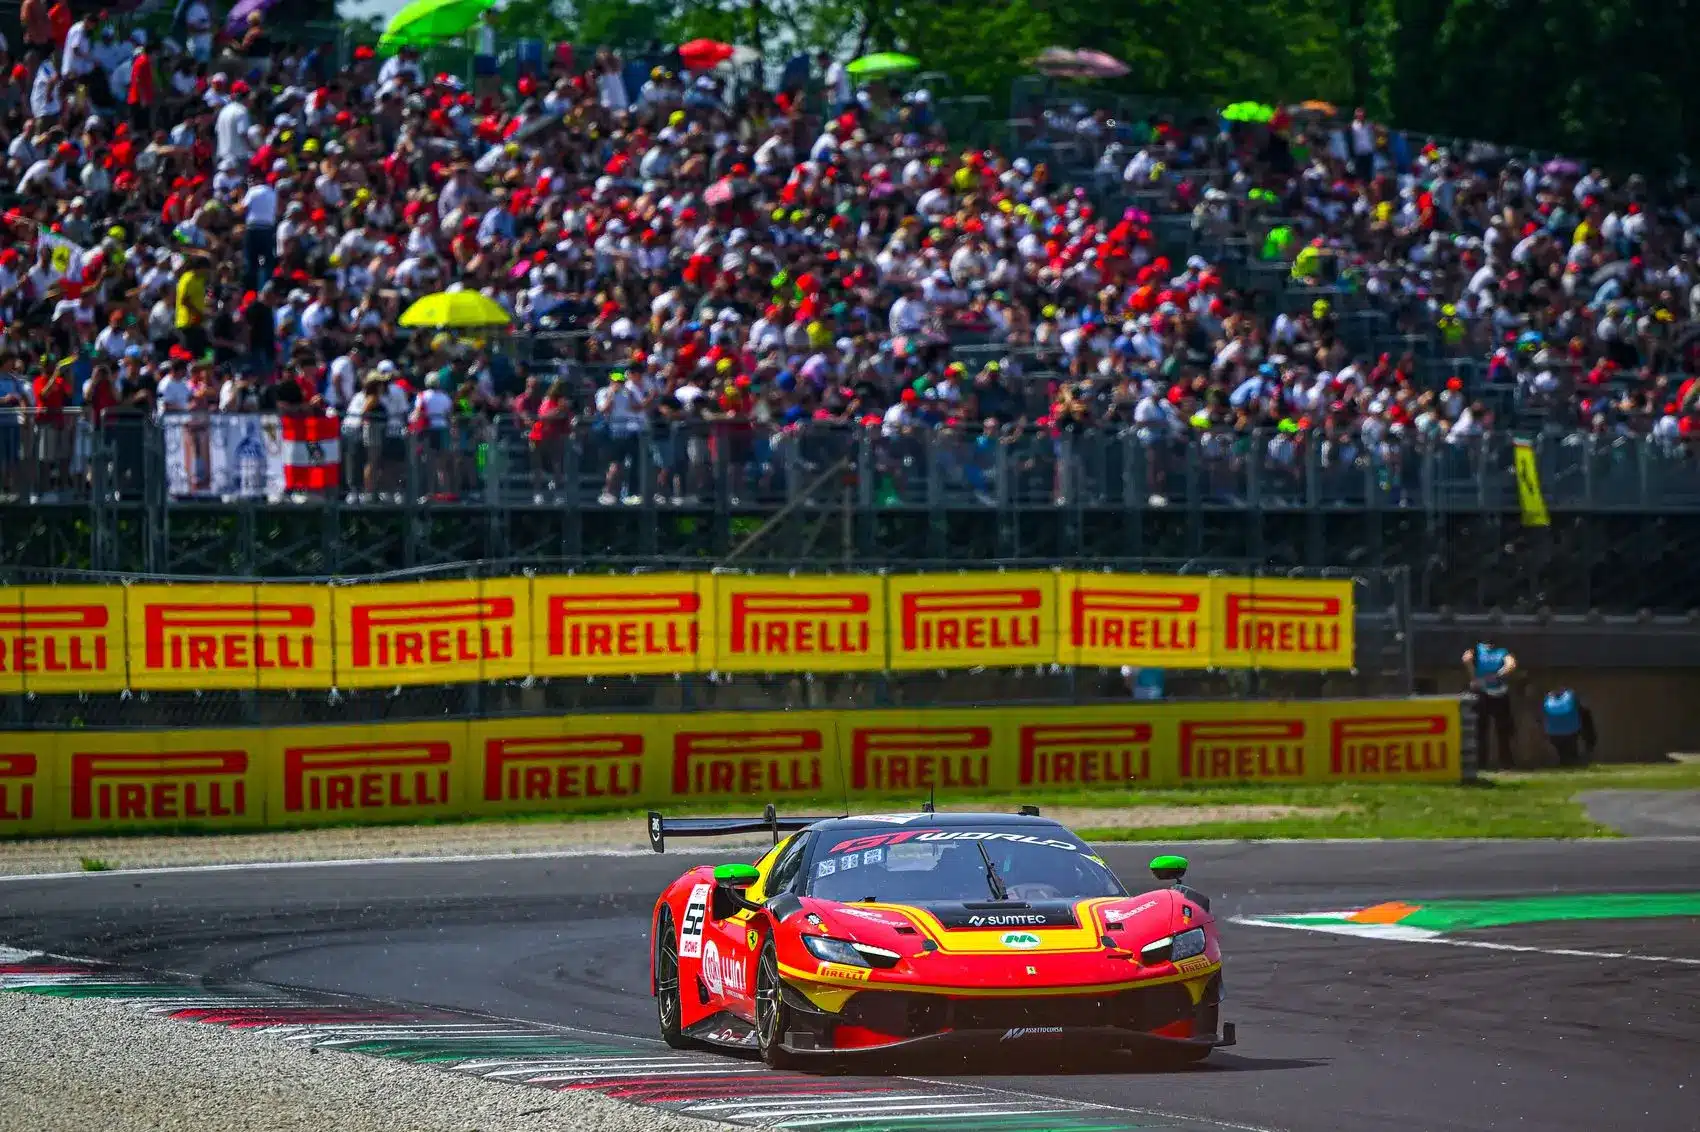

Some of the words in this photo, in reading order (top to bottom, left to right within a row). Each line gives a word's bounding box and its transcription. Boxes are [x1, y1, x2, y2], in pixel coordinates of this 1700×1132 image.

[145, 604, 315, 669] PIRELLI
[351, 597, 514, 667] PIRELLI
[548, 592, 700, 656] PIRELLI
[731, 593, 869, 652] PIRELLI
[902, 589, 1041, 651] PIRELLI
[1071, 589, 1200, 648] PIRELLI
[1225, 594, 1340, 652] PIRELLI
[484, 734, 644, 801] PIRELLI
[673, 730, 822, 793] PIRELLI
[852, 727, 990, 789] PIRELLI
[1020, 724, 1152, 785] PIRELLI
[1180, 720, 1305, 778] PIRELLI
[1331, 716, 1447, 774] PIRELLI
[71, 751, 248, 819] PIRELLI
[284, 742, 451, 811] PIRELLI
[828, 829, 943, 854] GT
[916, 832, 1077, 851] WORLD
[683, 903, 705, 935] 52
[988, 914, 1047, 926] SUMTEC
[820, 966, 865, 981] PIRELLI
